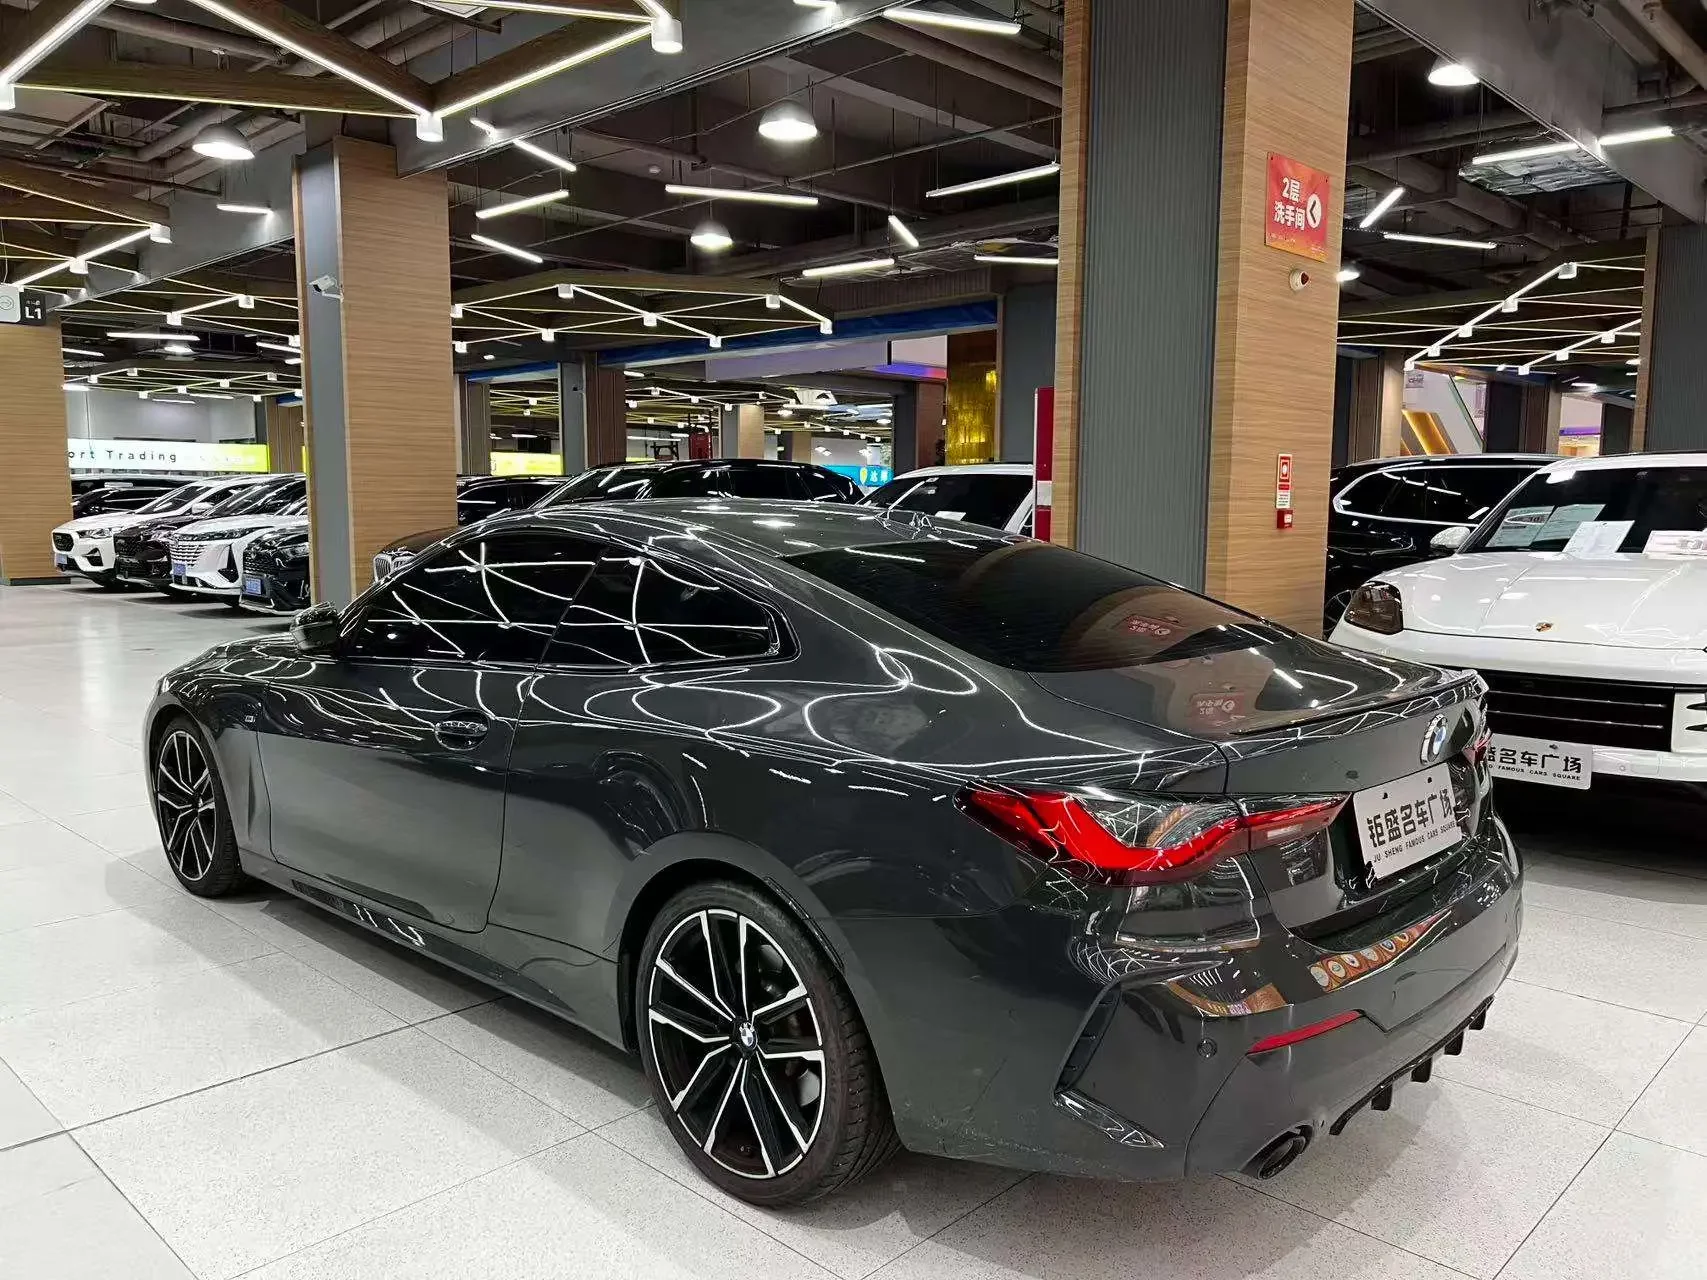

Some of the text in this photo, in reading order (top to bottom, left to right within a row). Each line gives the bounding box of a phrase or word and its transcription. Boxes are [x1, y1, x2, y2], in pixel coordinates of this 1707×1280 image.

[1282, 177, 1301, 202] 2层
[1273, 201, 1305, 230] 洗手间
[25, 306, 42, 319] L1
[106, 450, 177, 462] Trading
[1498, 765, 1525, 773] FAMOUS
[1374, 820, 1456, 862] JU SHENG FAMOUS CARS SQUARE
